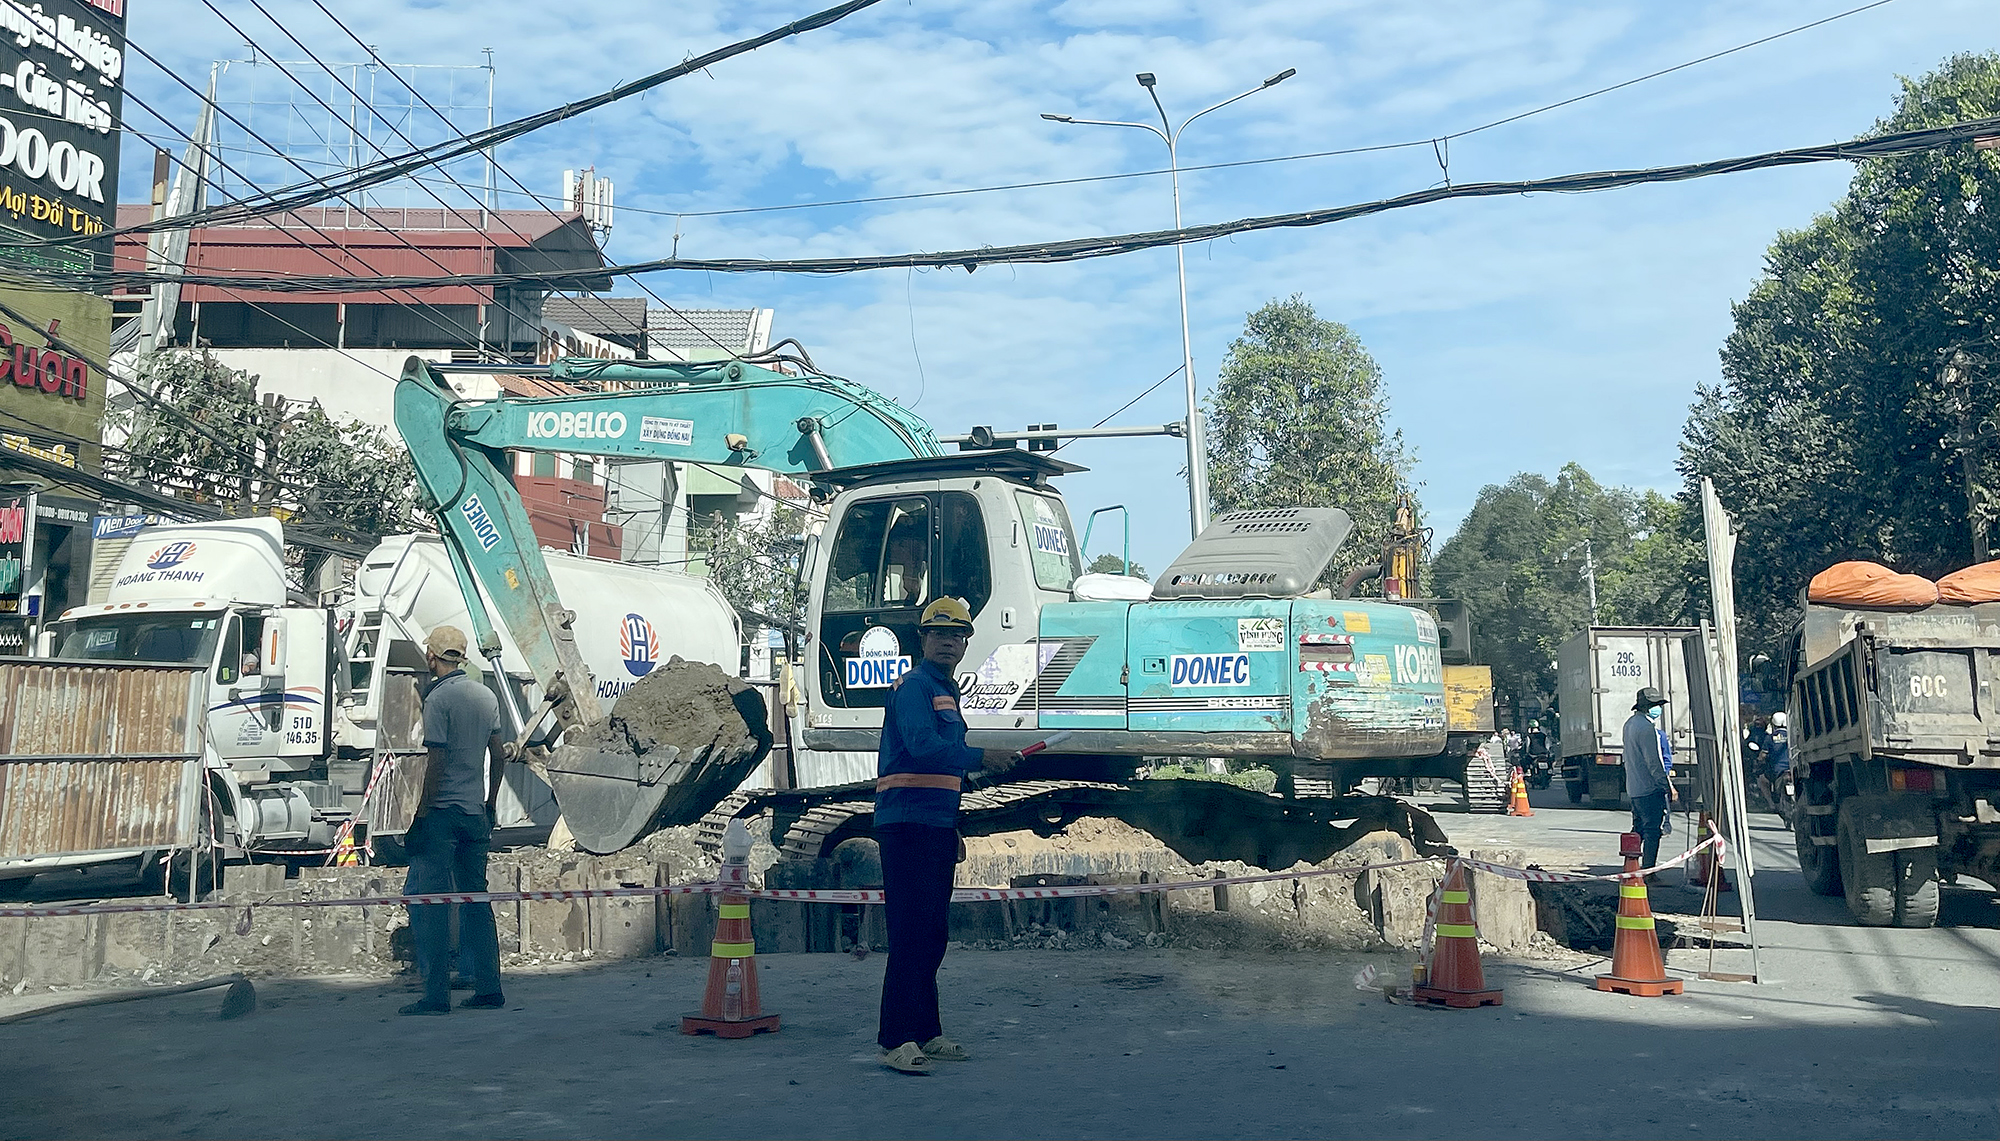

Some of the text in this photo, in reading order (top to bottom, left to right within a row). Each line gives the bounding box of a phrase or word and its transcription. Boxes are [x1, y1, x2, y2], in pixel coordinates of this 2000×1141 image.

[527, 411, 627, 439] KOBELCO
[462, 497, 501, 549] DONEC
[1035, 525, 1067, 554] DONEC
[1171, 655, 1249, 685] DONEC
[1616, 651, 1635, 664] 29C
[847, 658, 910, 686] DONEC
[1610, 664, 1642, 677] 140.83
[957, 671, 1020, 698] Dynamic
[1910, 674, 1947, 698] 60C
[962, 694, 1008, 709] Acera
[292, 716, 313, 730] 51D
[285, 731, 318, 744] 146.35
